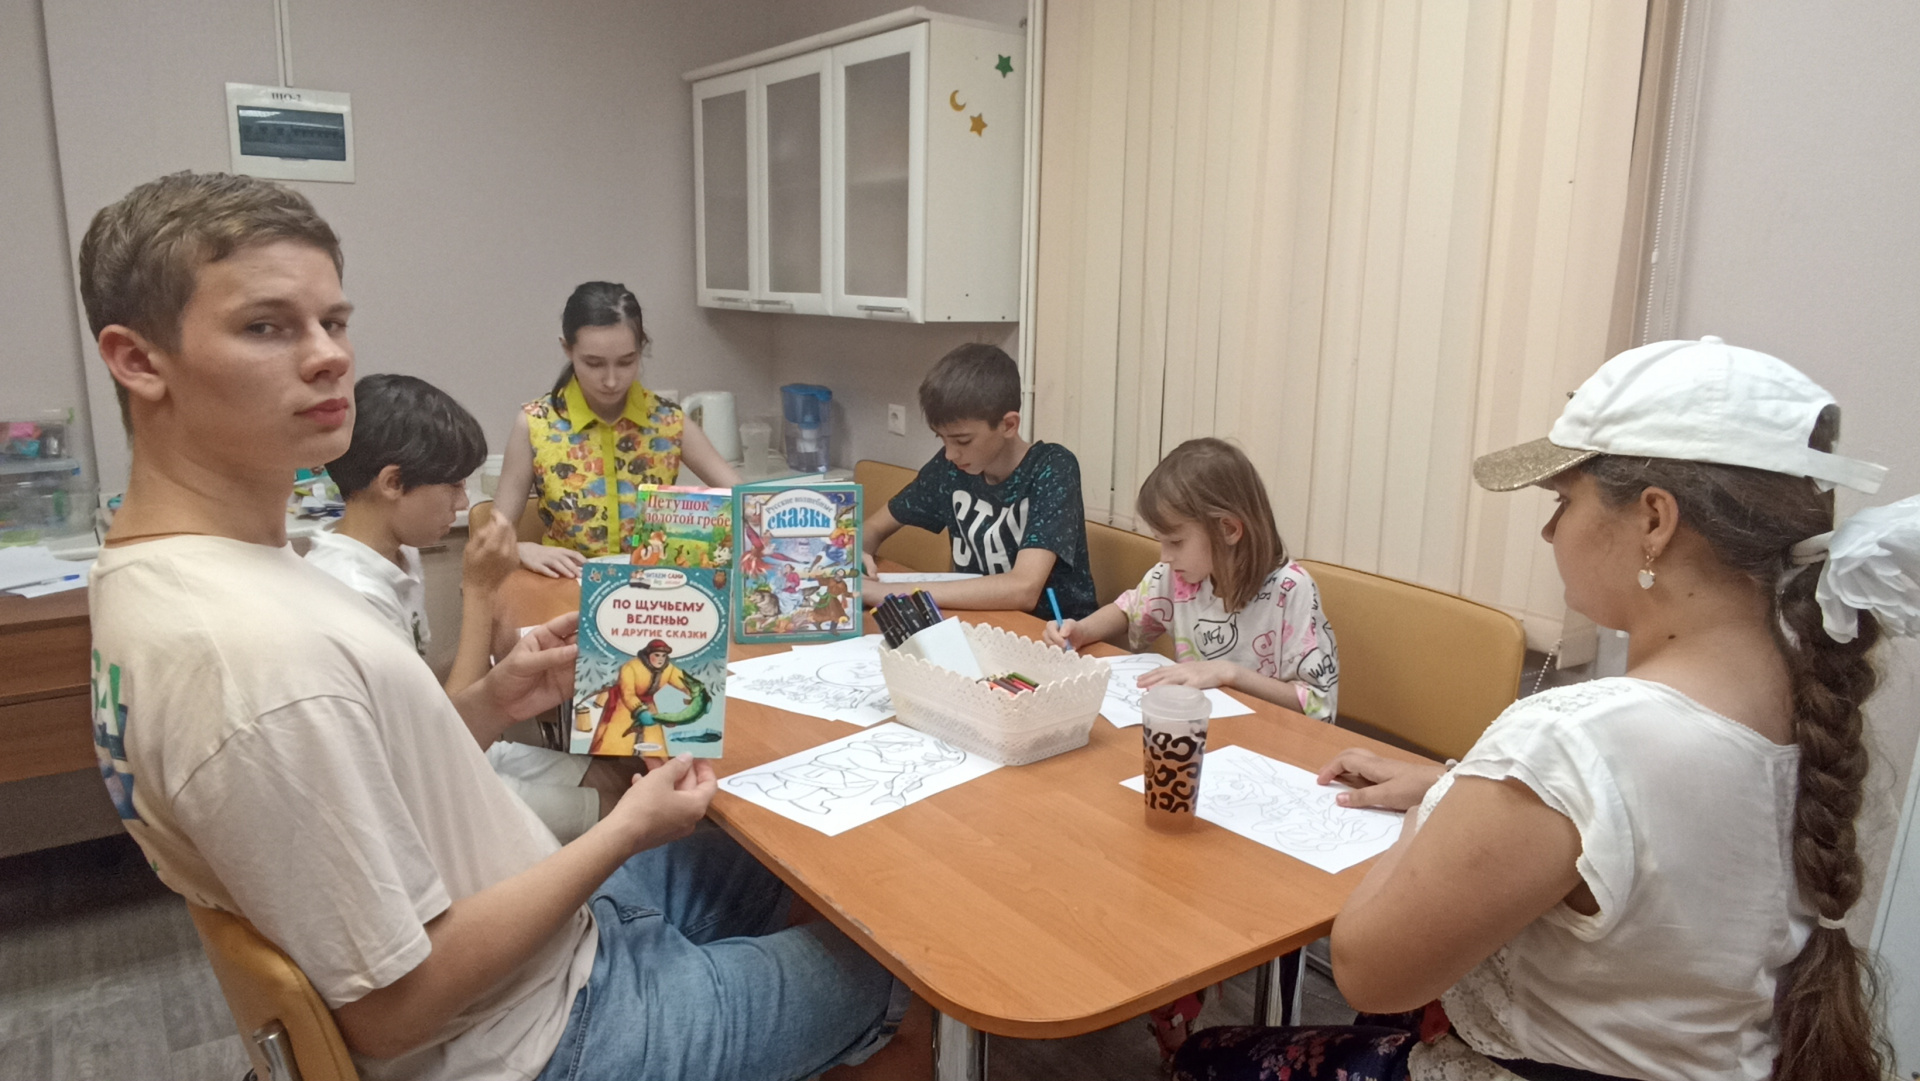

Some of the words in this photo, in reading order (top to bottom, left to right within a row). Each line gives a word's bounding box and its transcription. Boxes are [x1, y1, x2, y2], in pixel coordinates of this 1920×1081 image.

[647, 495, 709, 512] Петушок
[767, 507, 831, 530] сказки
[613, 599, 631, 609] ПО
[635, 599, 705, 612] ЩУЧЬЕМУ
[626, 613, 689, 626] ВЕЛЕНЬЮ
[611, 627, 619, 636] И
[622, 628, 663, 638] ДРУГИЕ
[665, 630, 707, 639] СКАЗКИ
